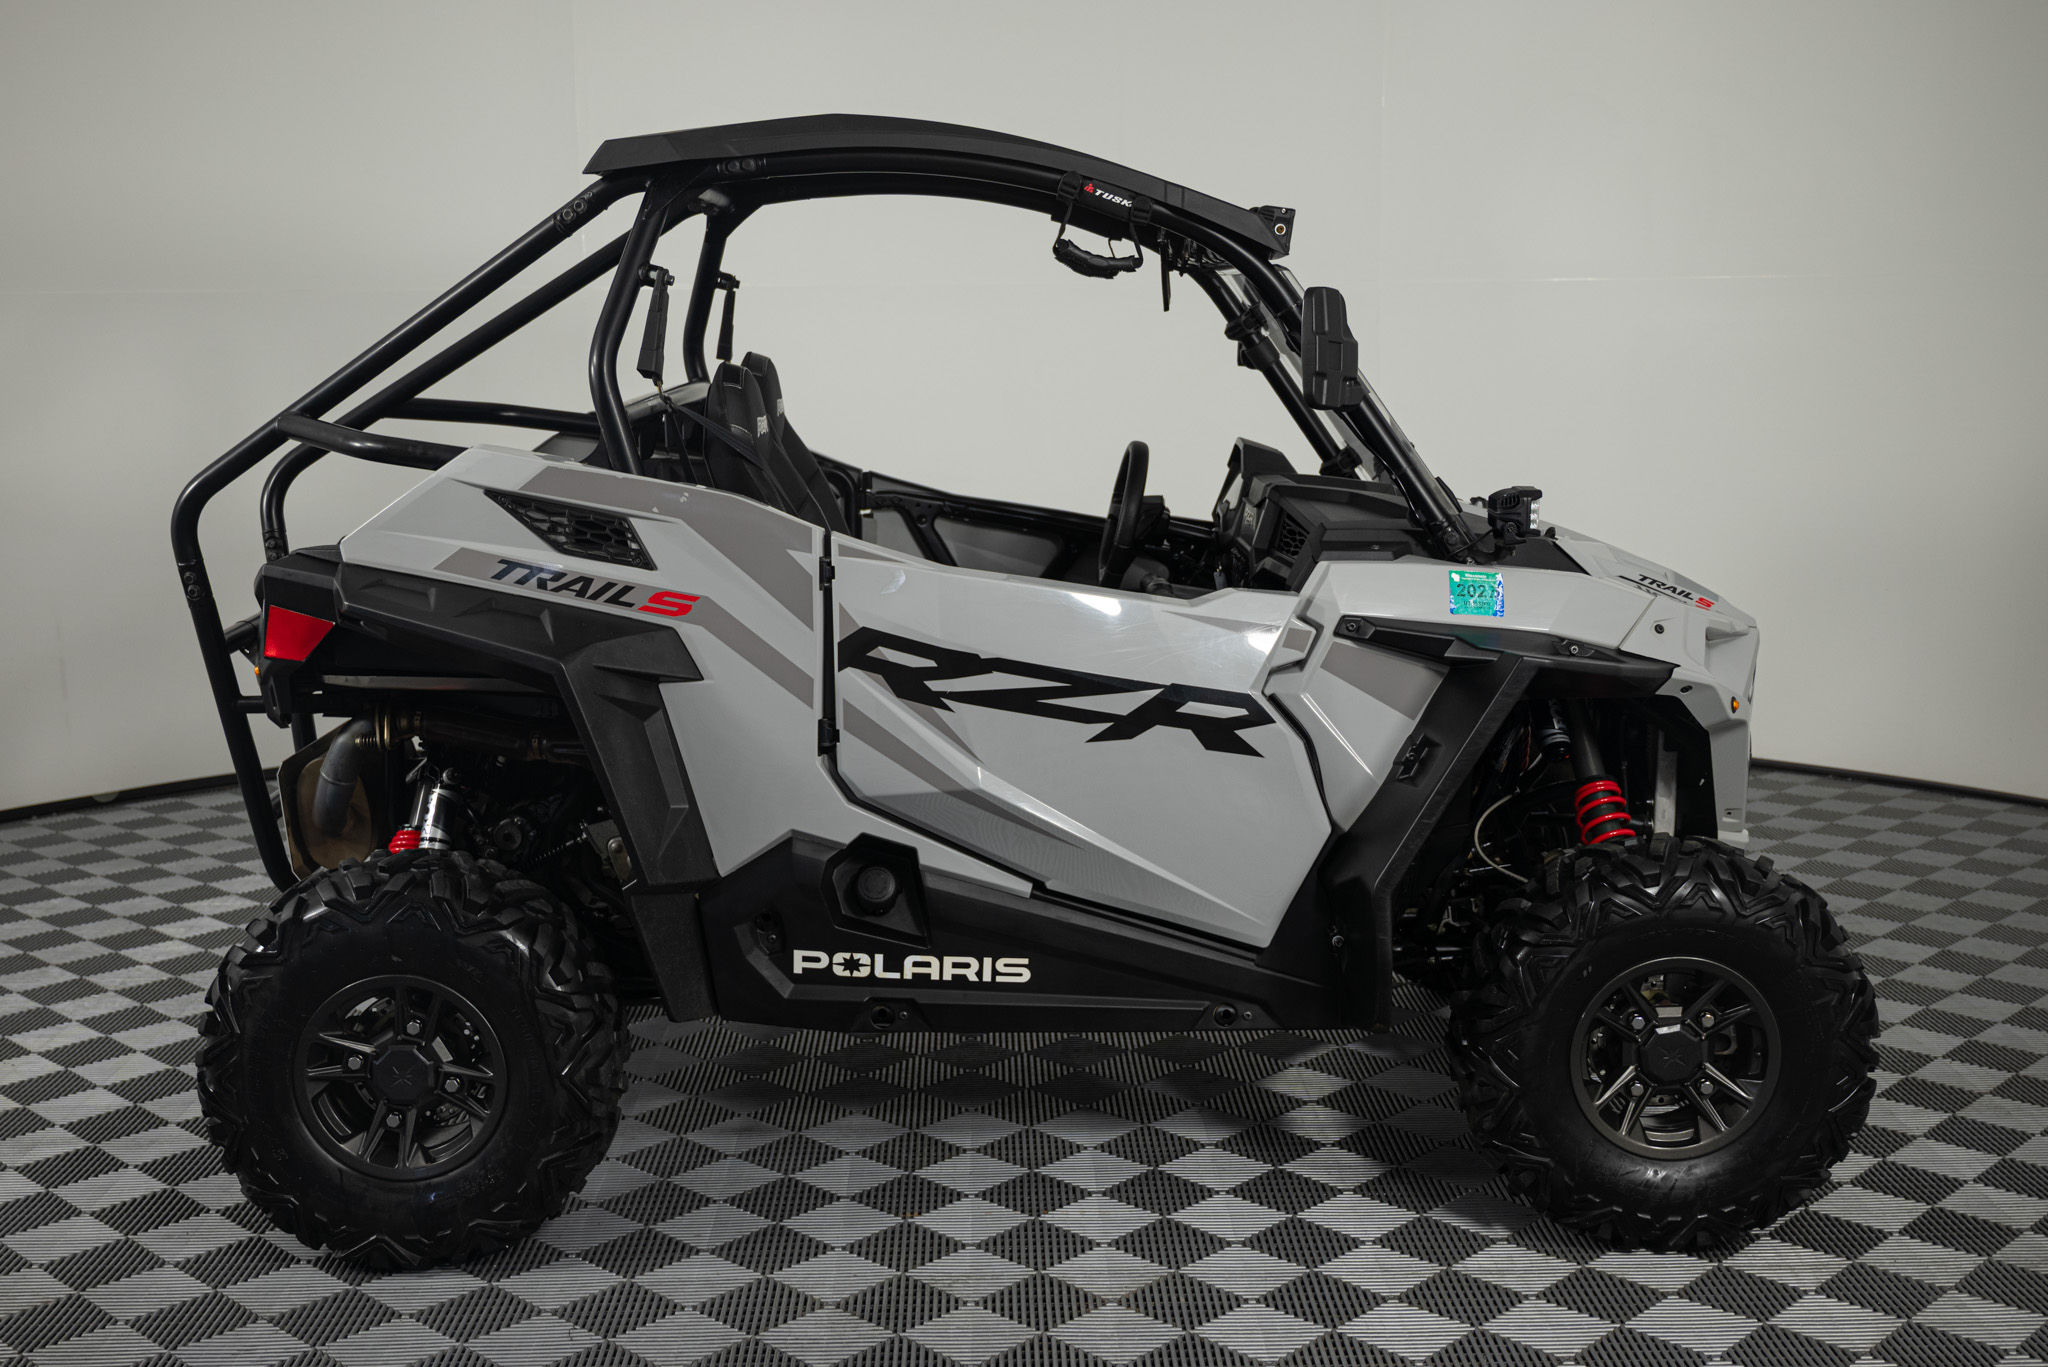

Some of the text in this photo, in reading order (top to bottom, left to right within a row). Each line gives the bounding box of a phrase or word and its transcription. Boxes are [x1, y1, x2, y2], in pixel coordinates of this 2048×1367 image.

[1094, 188, 1133, 207] TUSK
[490, 559, 700, 617] TRAIL S
[1638, 573, 1715, 608] TRAIL S
[838, 626, 1276, 758] RZR
[793, 949, 1032, 983] POLARIS
